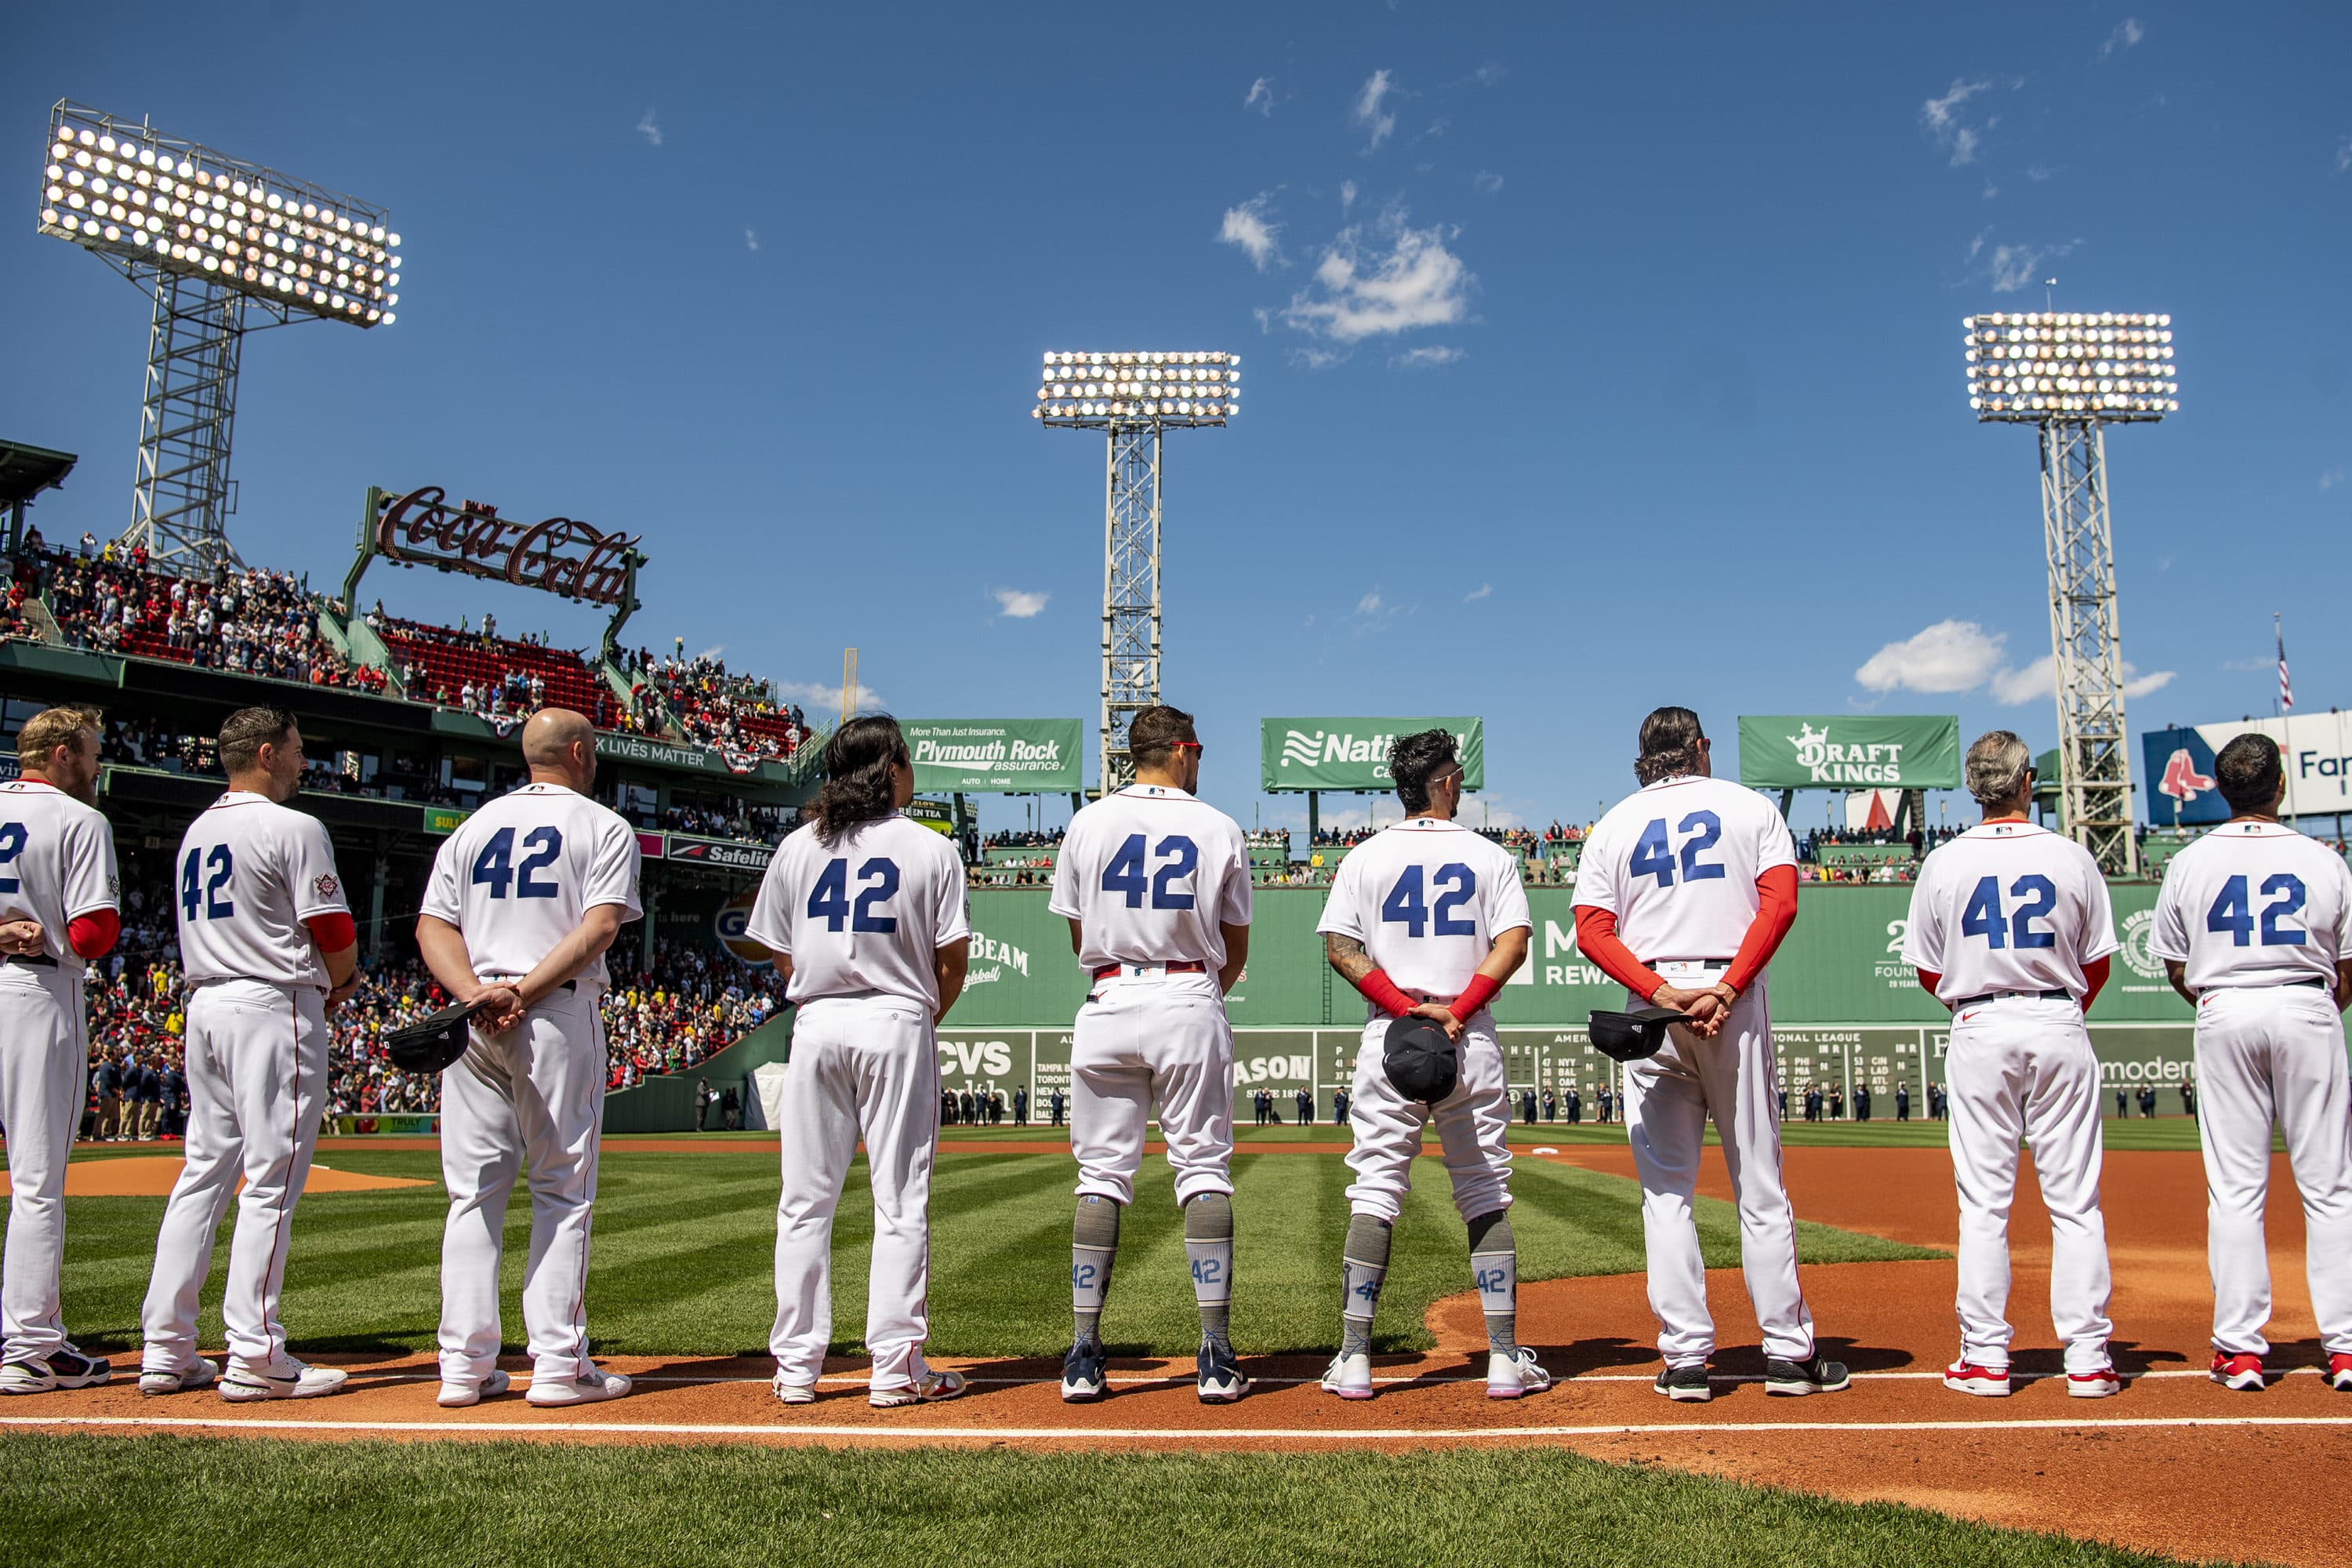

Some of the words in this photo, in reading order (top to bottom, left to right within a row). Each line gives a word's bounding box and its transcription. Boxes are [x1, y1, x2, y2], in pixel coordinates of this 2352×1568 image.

[910, 728, 930, 736] More
[932, 728, 950, 736] Than
[952, 728, 967, 736] Just
[968, 728, 1007, 736] Insurance.
[915, 740, 1006, 762] Plymouth
[1010, 739, 1060, 760] Rock
[1323, 733, 1465, 762] Natil
[609, 739, 648, 758] LIVES
[652, 747, 705, 767] MATTER
[1796, 742, 1903, 767] DRAFT
[1373, 765, 1391, 778] Ca
[1811, 762, 1900, 782] KINGS
[898, 807, 924, 817] REEN
[924, 809, 941, 818] TEA
[1630, 811, 1726, 888] 42
[0, 822, 29, 894] 2
[472, 826, 562, 899] 42
[1102, 833, 1198, 910] 42
[182, 844, 234, 921] 42
[808, 858, 899, 933] 42
[1382, 864, 1476, 938] 42
[1962, 875, 2056, 950] 42
[2207, 874, 2307, 947] 42
[968, 931, 1028, 978] BEAM
[962, 965, 1001, 993] ghball
[1555, 1035, 1592, 1044] AMER
[1772, 1033, 1809, 1043] IONAL
[1815, 1033, 1861, 1043] LEAGUE
[1336, 1047, 1343, 1055] P
[1511, 1046, 1518, 1054] H
[1525, 1046, 1531, 1054] E
[1543, 1046, 1550, 1054] P
[1584, 1046, 1594, 1054] IN
[1777, 1044, 1784, 1054] P
[1819, 1044, 1828, 1054] IN
[1832, 1044, 1840, 1054] R
[1855, 1044, 1862, 1054] P
[1896, 1044, 1906, 1053] IN
[1909, 1044, 1917, 1053] R
[937, 1041, 1011, 1076] CVS
[1558, 1058, 1576, 1067] NYY
[1795, 1058, 1810, 1066] PHI
[1871, 1057, 1887, 1065] CIN
[1037, 1064, 1062, 1073] TAMPA
[1585, 1062, 1593, 1072] N
[1820, 1062, 1828, 1071] N
[1871, 1066, 1889, 1075] LAD
[1897, 1061, 1905, 1070] N
[2100, 1055, 2196, 1080] moder
[1233, 1055, 1312, 1088] ASON
[1335, 1072, 1344, 1080] 37
[1558, 1068, 1576, 1076] BAL
[1795, 1067, 1810, 1076] MIA
[1559, 1078, 1576, 1087] OAK
[1872, 1076, 1888, 1085] ATL
[1586, 1083, 1594, 1091] N
[1821, 1082, 1829, 1091] N
[1875, 1086, 1887, 1094] SD
[1587, 1102, 1594, 1111] N
[1823, 1101, 1830, 1110] N
[392, 1117, 421, 1127] TRULY
[1192, 1259, 1221, 1283] 42
[1073, 1264, 1095, 1289] 42
[1477, 1269, 1506, 1293] 42
[1356, 1281, 1382, 1301] 42
